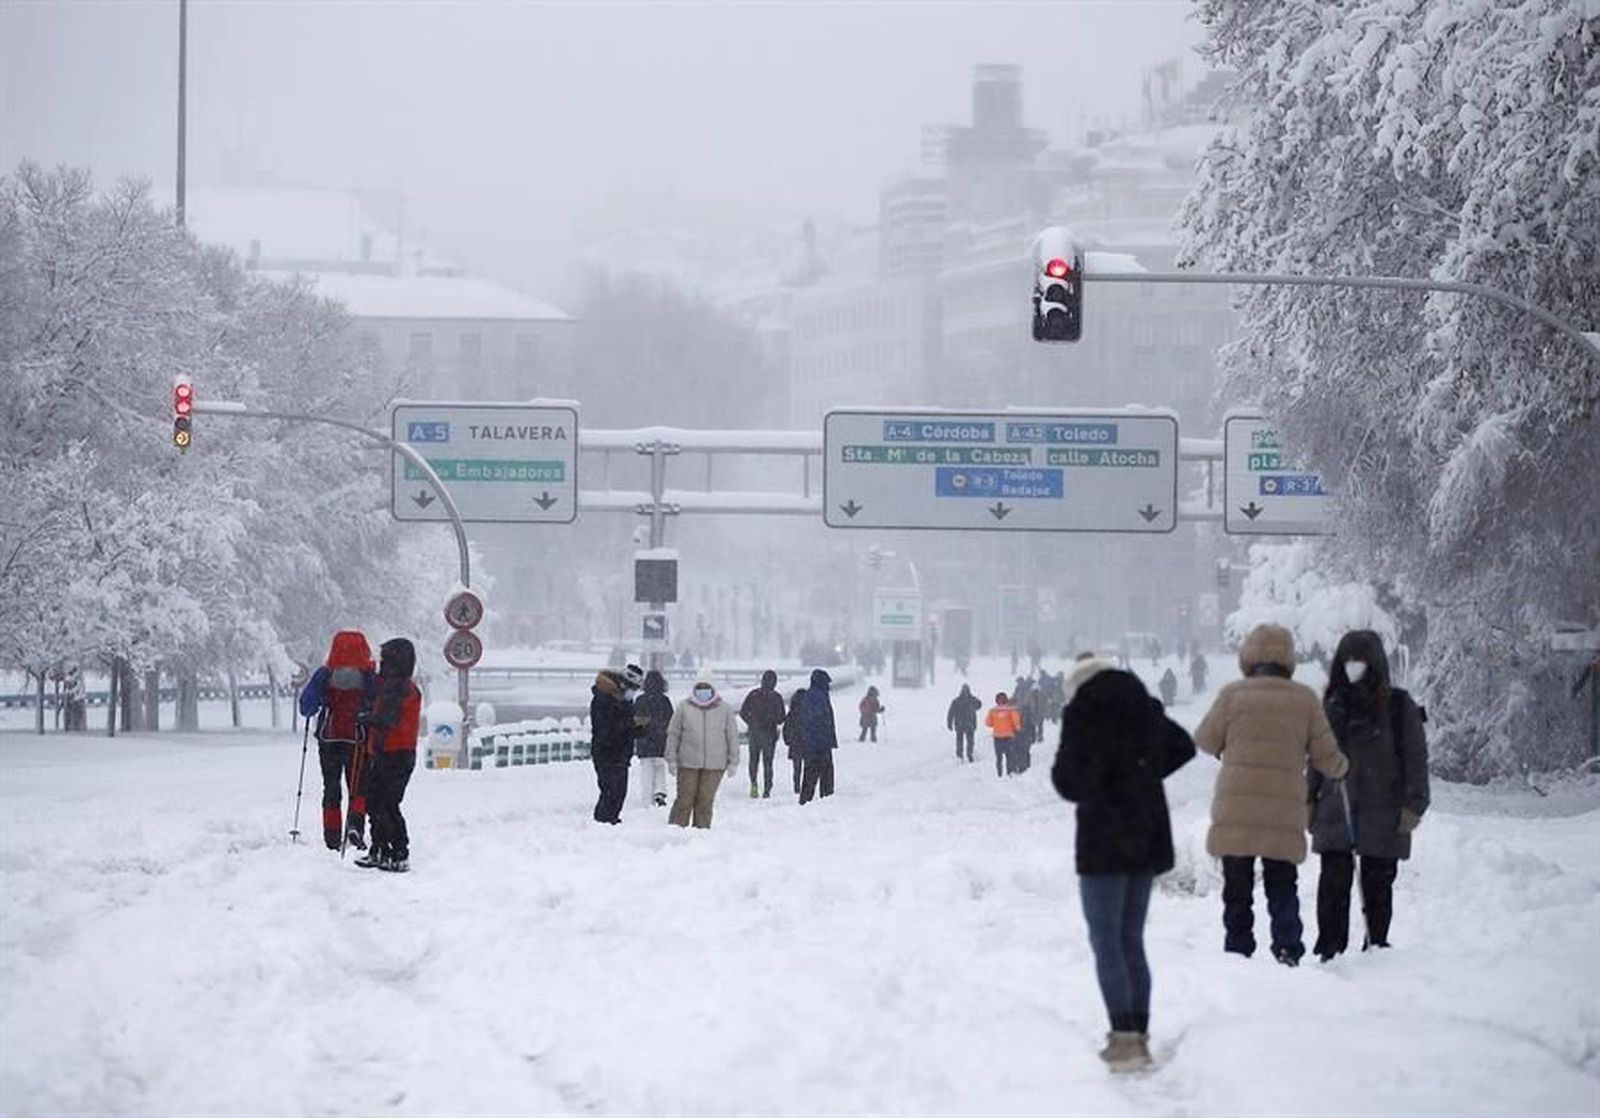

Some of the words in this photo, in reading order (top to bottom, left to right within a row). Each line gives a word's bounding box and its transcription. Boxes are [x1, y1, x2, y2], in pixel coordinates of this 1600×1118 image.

[412, 425, 447, 440] A-5
[469, 426, 567, 440] TALAVERA
[888, 426, 911, 437] A-4
[922, 424, 989, 439] Córdoba
[1011, 427, 1044, 439] A-42
[1053, 427, 1109, 441] Toledo
[916, 449, 936, 462] de
[945, 450, 960, 462] la
[1050, 451, 1089, 465] calle
[1100, 452, 1157, 466] Atocha
[456, 464, 562, 480] Embajadores
[1003, 469, 1043, 481] Toledo
[455, 642, 473, 657] 50
